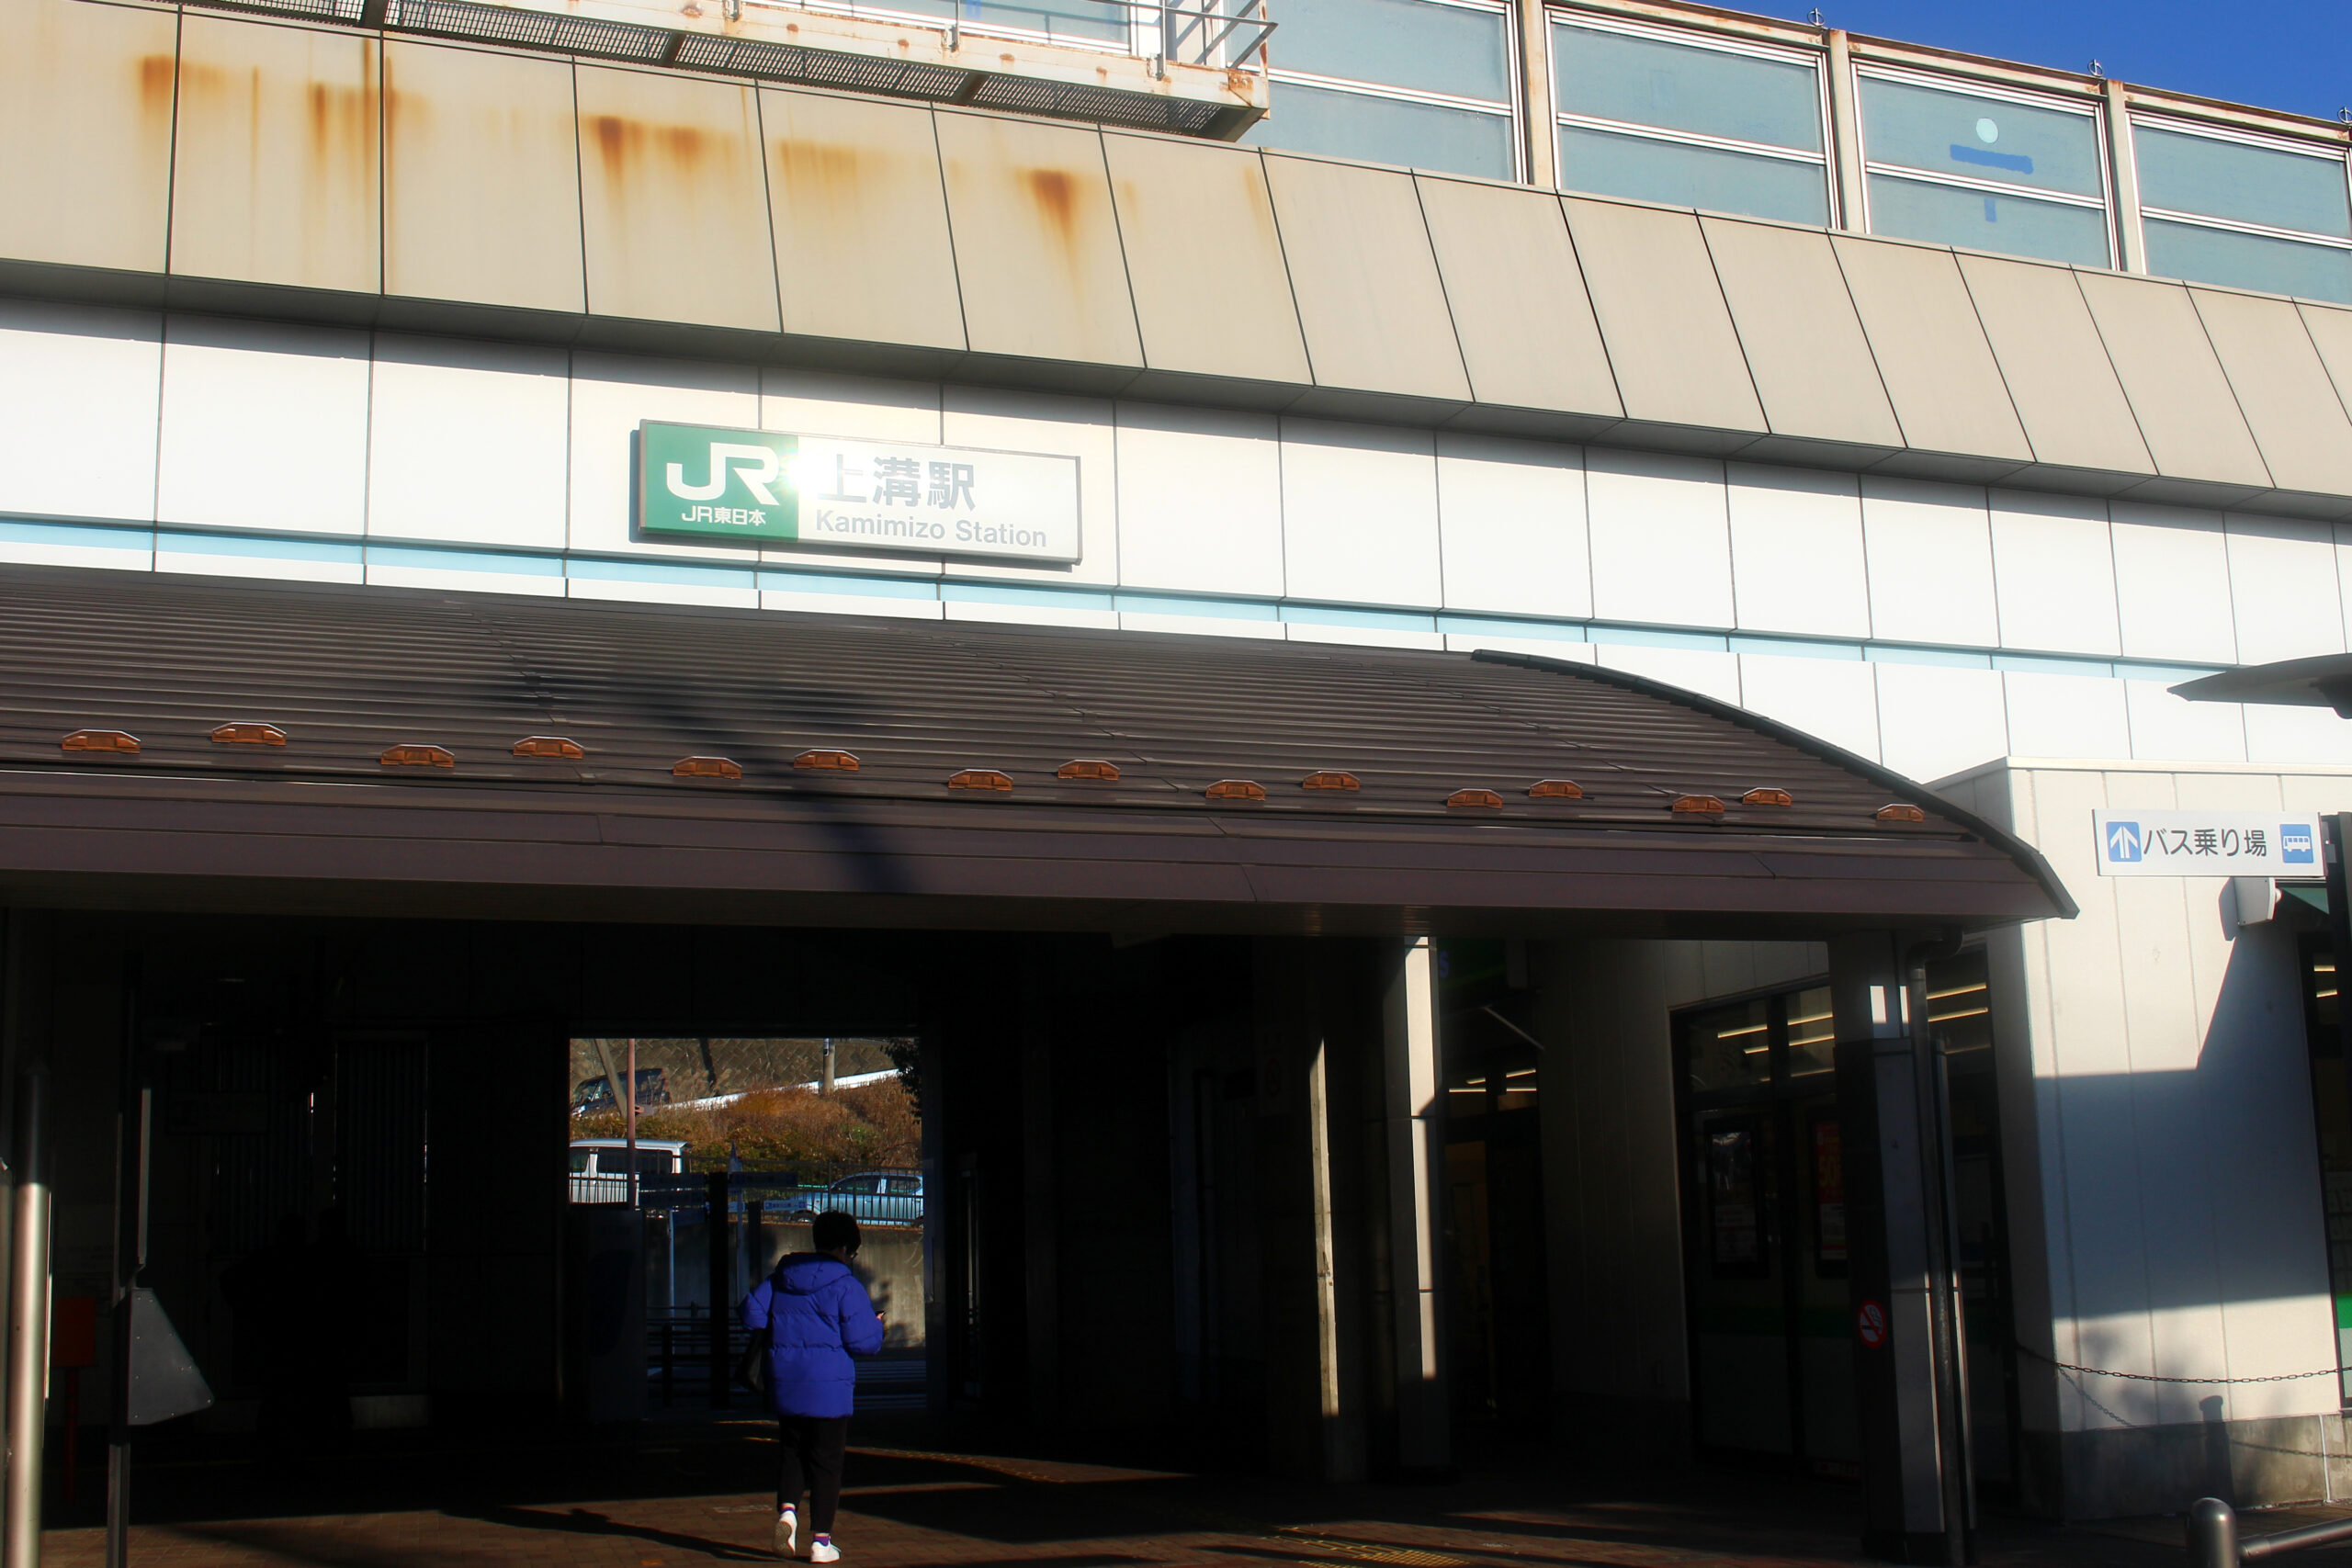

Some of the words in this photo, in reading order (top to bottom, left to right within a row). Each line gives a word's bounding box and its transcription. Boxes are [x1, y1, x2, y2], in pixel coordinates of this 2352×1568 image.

[666, 442, 780, 505] JR
[818, 454, 977, 512] 上溝駅
[682, 505, 766, 526] JR東日本
[816, 509, 945, 540] Kamimizo
[956, 519, 1046, 547] Station
[2143, 828, 2267, 857] バス乗り場
